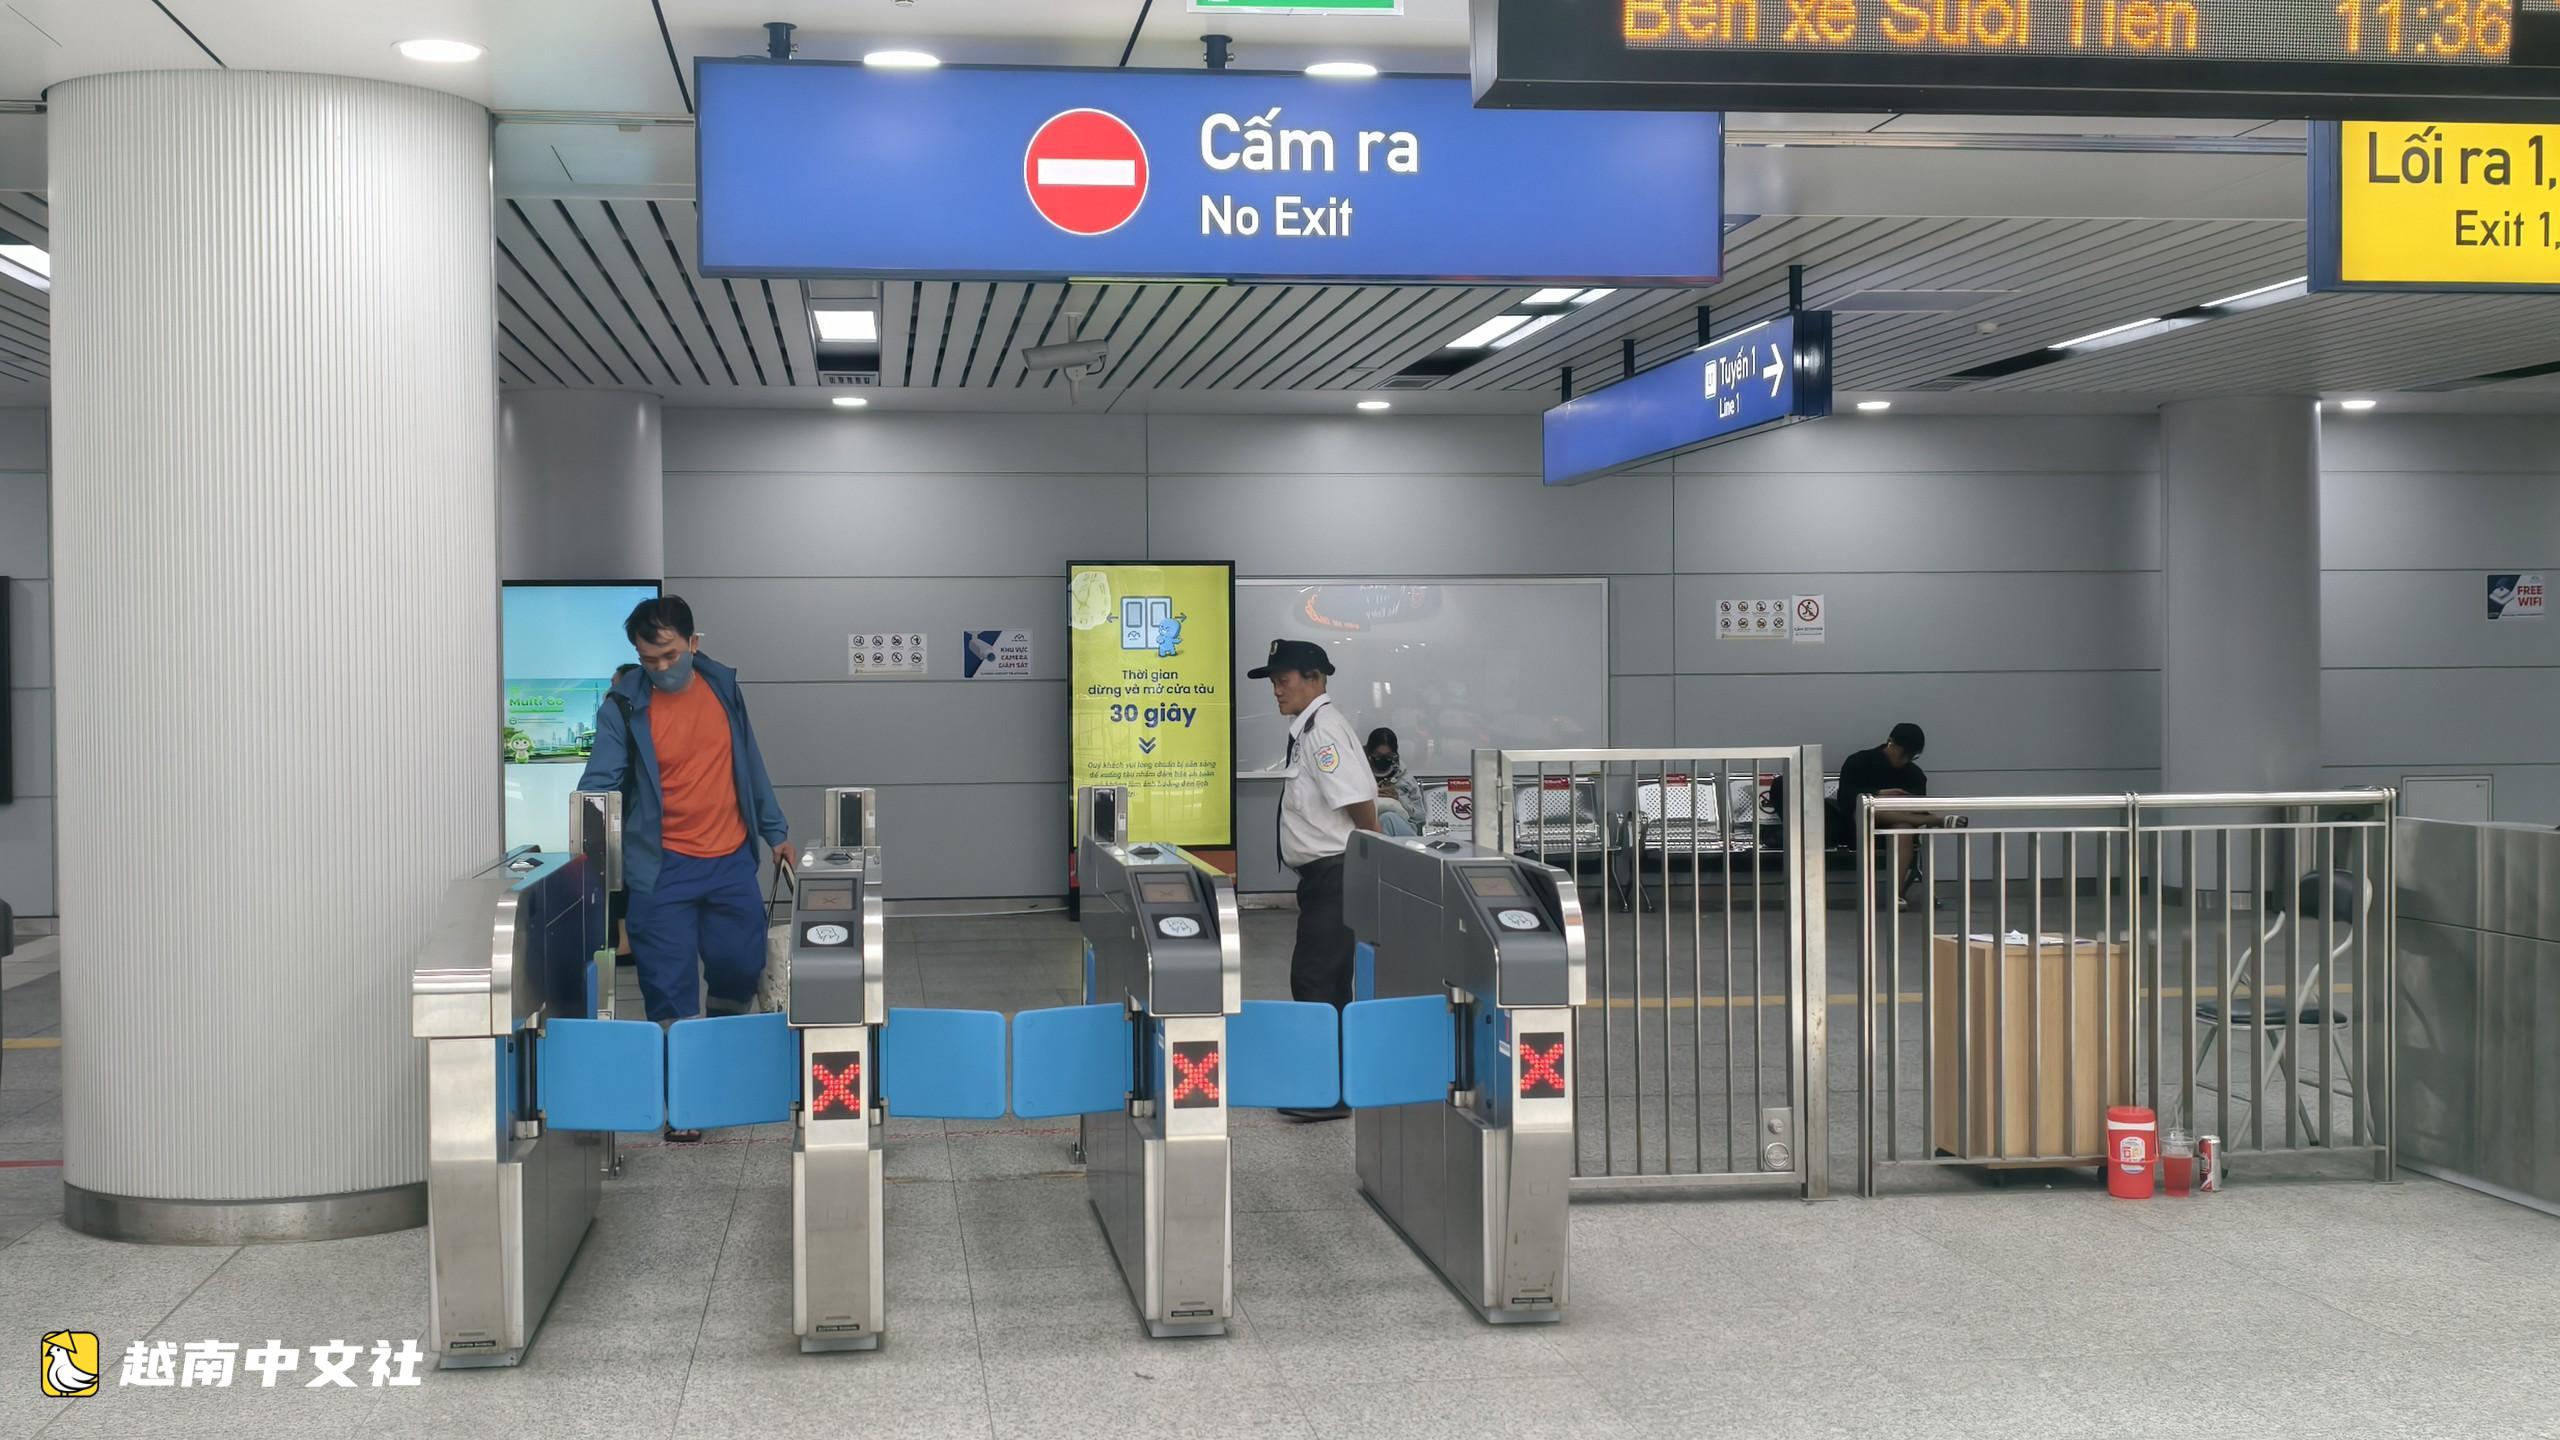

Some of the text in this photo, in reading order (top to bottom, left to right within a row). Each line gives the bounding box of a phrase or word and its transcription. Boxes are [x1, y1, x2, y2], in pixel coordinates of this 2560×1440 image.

[2337, 0, 2512, 52] 11:36
[1201, 107, 1418, 173] Cấm ra
[2368, 125, 2443, 184] Lối
[2460, 147, 2511, 186] ra
[1201, 195, 1353, 237] No Exit
[2455, 209, 2525, 247] Exit
[1719, 345, 1756, 390] Tuyến 1
[1719, 392, 1740, 418] Line 1
[2517, 585, 2543, 595] FREE
[2518, 597, 2542, 607] WIFI
[1088, 684, 1121, 697] dừng
[1122, 669, 1178, 682] Thời gian
[1110, 702, 1196, 728] 30 giây
